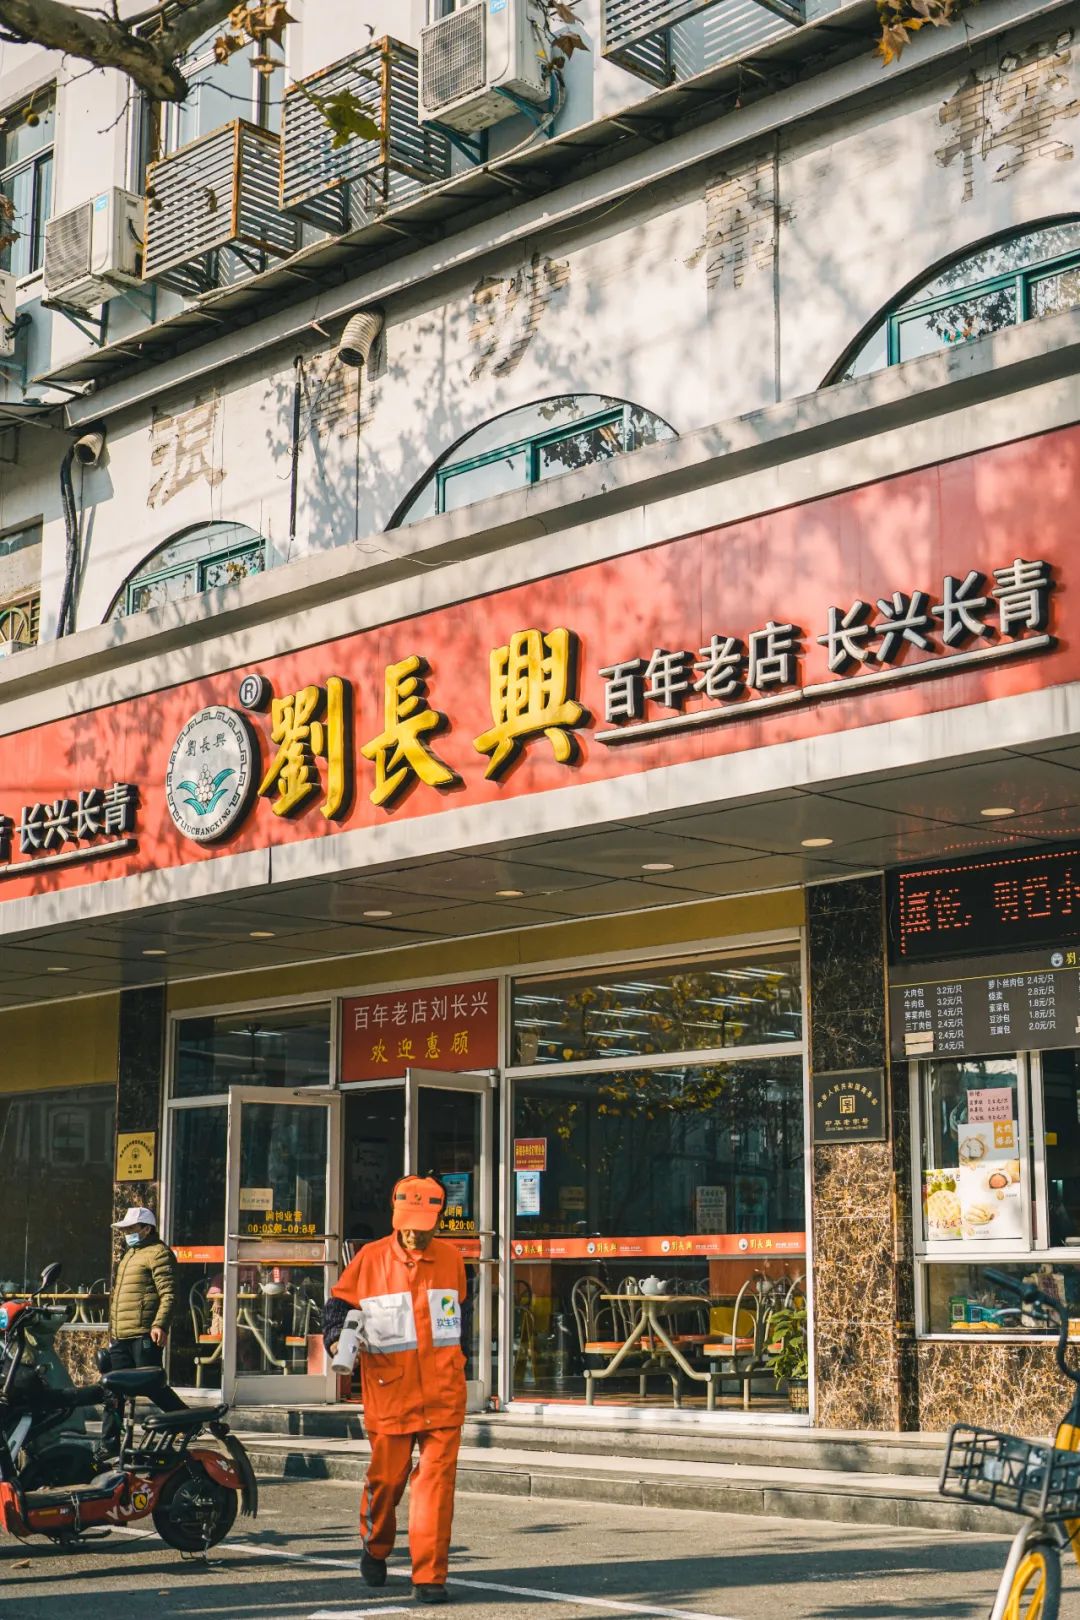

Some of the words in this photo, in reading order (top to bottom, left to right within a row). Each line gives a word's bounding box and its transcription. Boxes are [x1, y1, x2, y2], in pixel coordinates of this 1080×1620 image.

[598, 620, 793, 722] 百年老店
[817, 557, 1048, 672] 长兴长青
[258, 628, 584, 820] 劉長興
[15, 782, 131, 852] 长兴长青
[180, 808, 231, 836] LIUCHANGXING
[1027, 974, 1055, 985] 2.4元/只
[904, 988, 924, 999] 大肉包
[936, 984, 963, 996] 3.2元/只
[1028, 986, 1056, 996] 2.8元/只
[904, 1000, 925, 1009] 牛肉包
[936, 996, 963, 1006] 3.2元/只
[1029, 997, 1056, 1007] 1.8元/只
[354, 991, 489, 1031] 百年老店刘长兴
[937, 1007, 964, 1017] 2.4元/只
[989, 1014, 1010, 1024] 豆沙包
[1029, 1009, 1056, 1019] 1.8元/只
[905, 1021, 932, 1032] 三丁肉包
[937, 1018, 964, 1029] 2.4元/只
[1029, 1020, 1056, 1031] 2.0元/只
[938, 1029, 965, 1040] 2.4元/只
[370, 1030, 470, 1063] 欢迎惠顾
